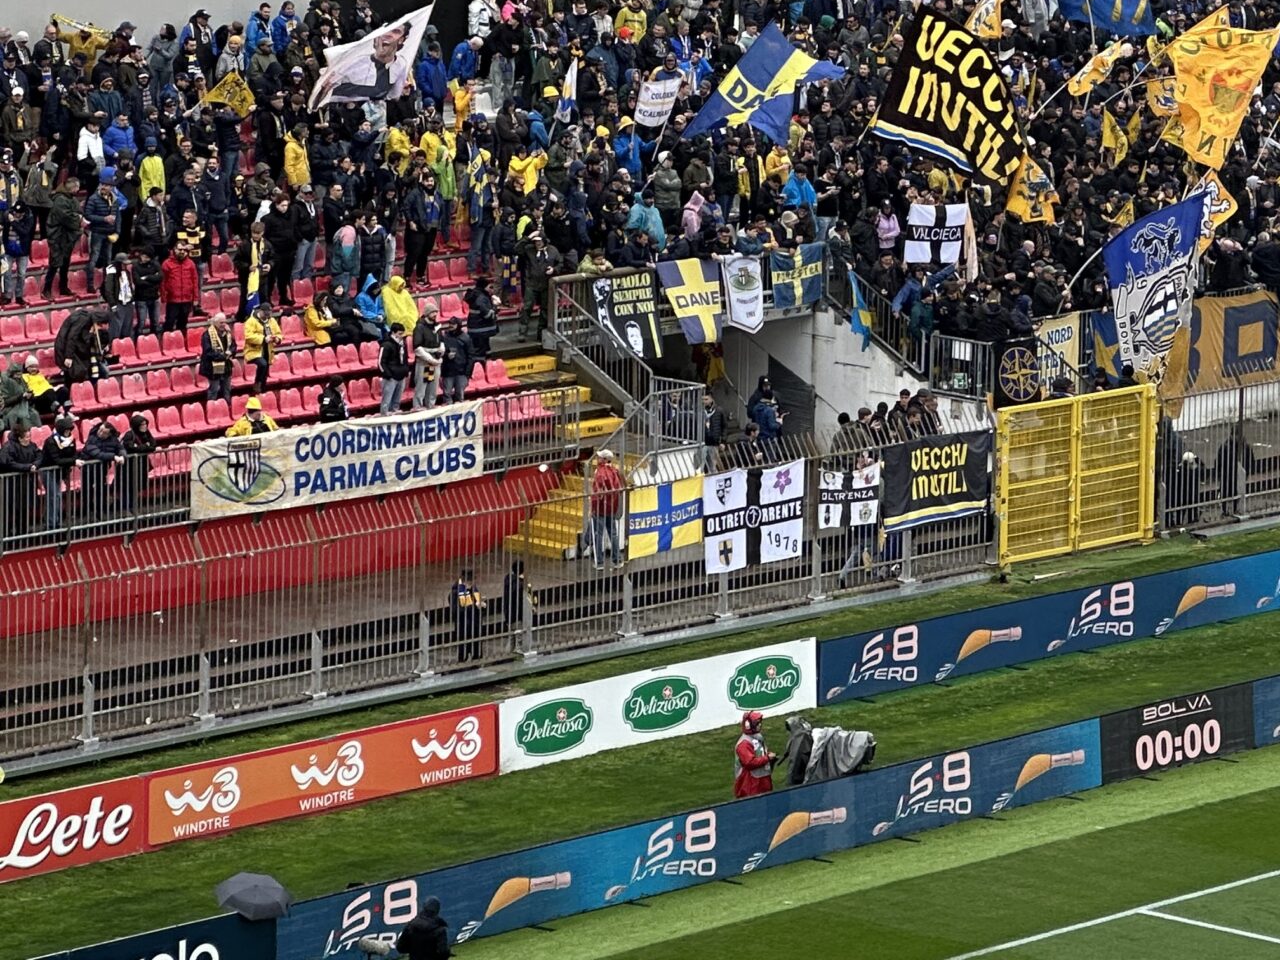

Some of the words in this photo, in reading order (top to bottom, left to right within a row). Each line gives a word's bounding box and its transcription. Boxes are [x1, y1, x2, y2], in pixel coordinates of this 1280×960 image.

[912, 226, 961, 241] VALCIECA
[612, 272, 651, 290] PAOLO
[613, 287, 653, 304] SEMPRE
[675, 290, 721, 309] DANE
[614, 303, 635, 317] CON
[636, 300, 656, 315] NOI
[1047, 326, 1073, 346] NORD
[1119, 321, 1131, 355] BOYS
[294, 411, 476, 462] COORDINAMENTO
[911, 443, 968, 472] VECCHI
[294, 459, 387, 497] PARMA
[395, 443, 477, 481] CLUBS
[629, 515, 663, 530] SEMPRE
[767, 530, 798, 554] 1978
[734, 668, 798, 698] Deliziosa
[630, 689, 695, 719] Deliziosa
[1143, 693, 1212, 721] BOLVA
[523, 712, 590, 743] Deliziosa
[1135, 719, 1222, 771] 00:00
[420, 762, 474, 785] WINDTRE
[299, 788, 355, 811] WINDTRE
[0, 796, 133, 869] Lete
[173, 815, 231, 839] WINDTRE
